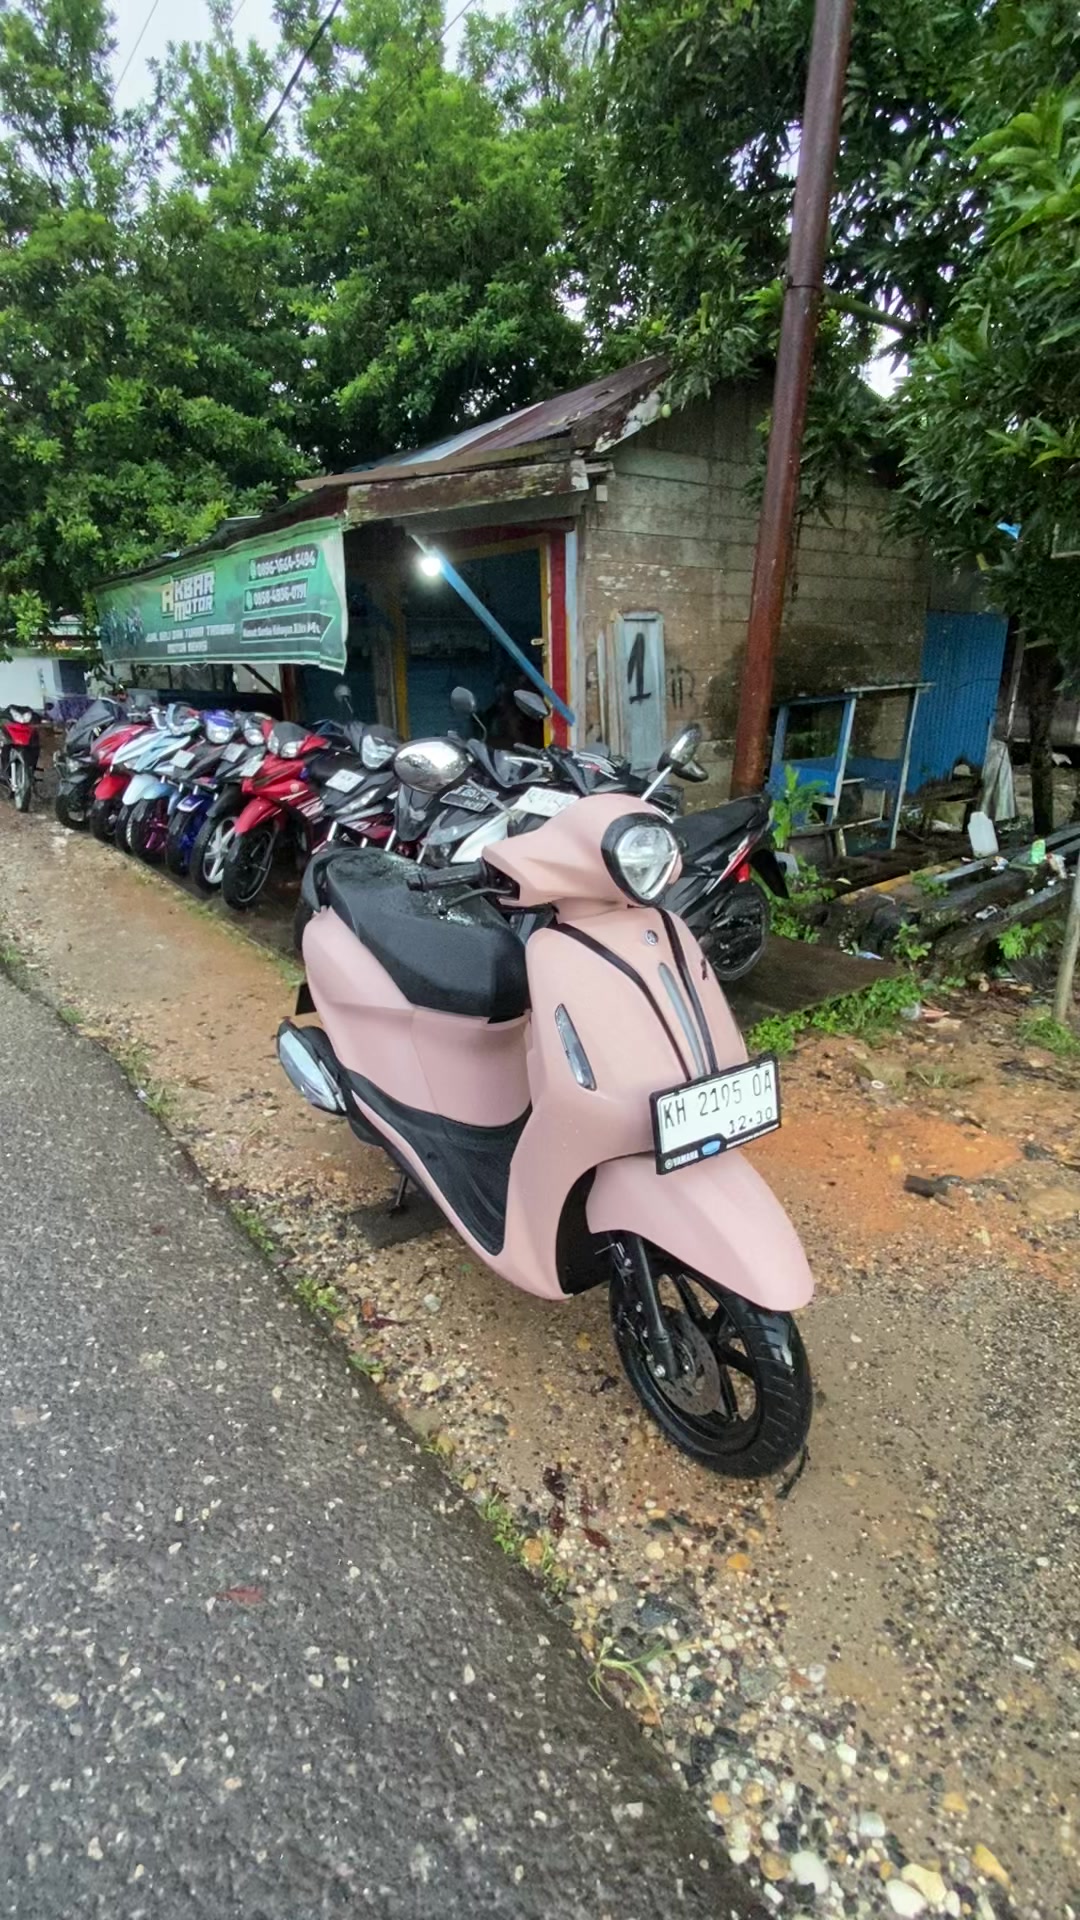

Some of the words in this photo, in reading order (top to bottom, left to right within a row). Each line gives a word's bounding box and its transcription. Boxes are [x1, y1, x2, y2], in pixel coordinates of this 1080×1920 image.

[161, 571, 215, 613] AKBAR
[174, 595, 214, 622] MOTOR
[627, 632, 652, 704] 1
[663, 1097, 687, 1129] KH
[698, 1080, 742, 1117] 2195
